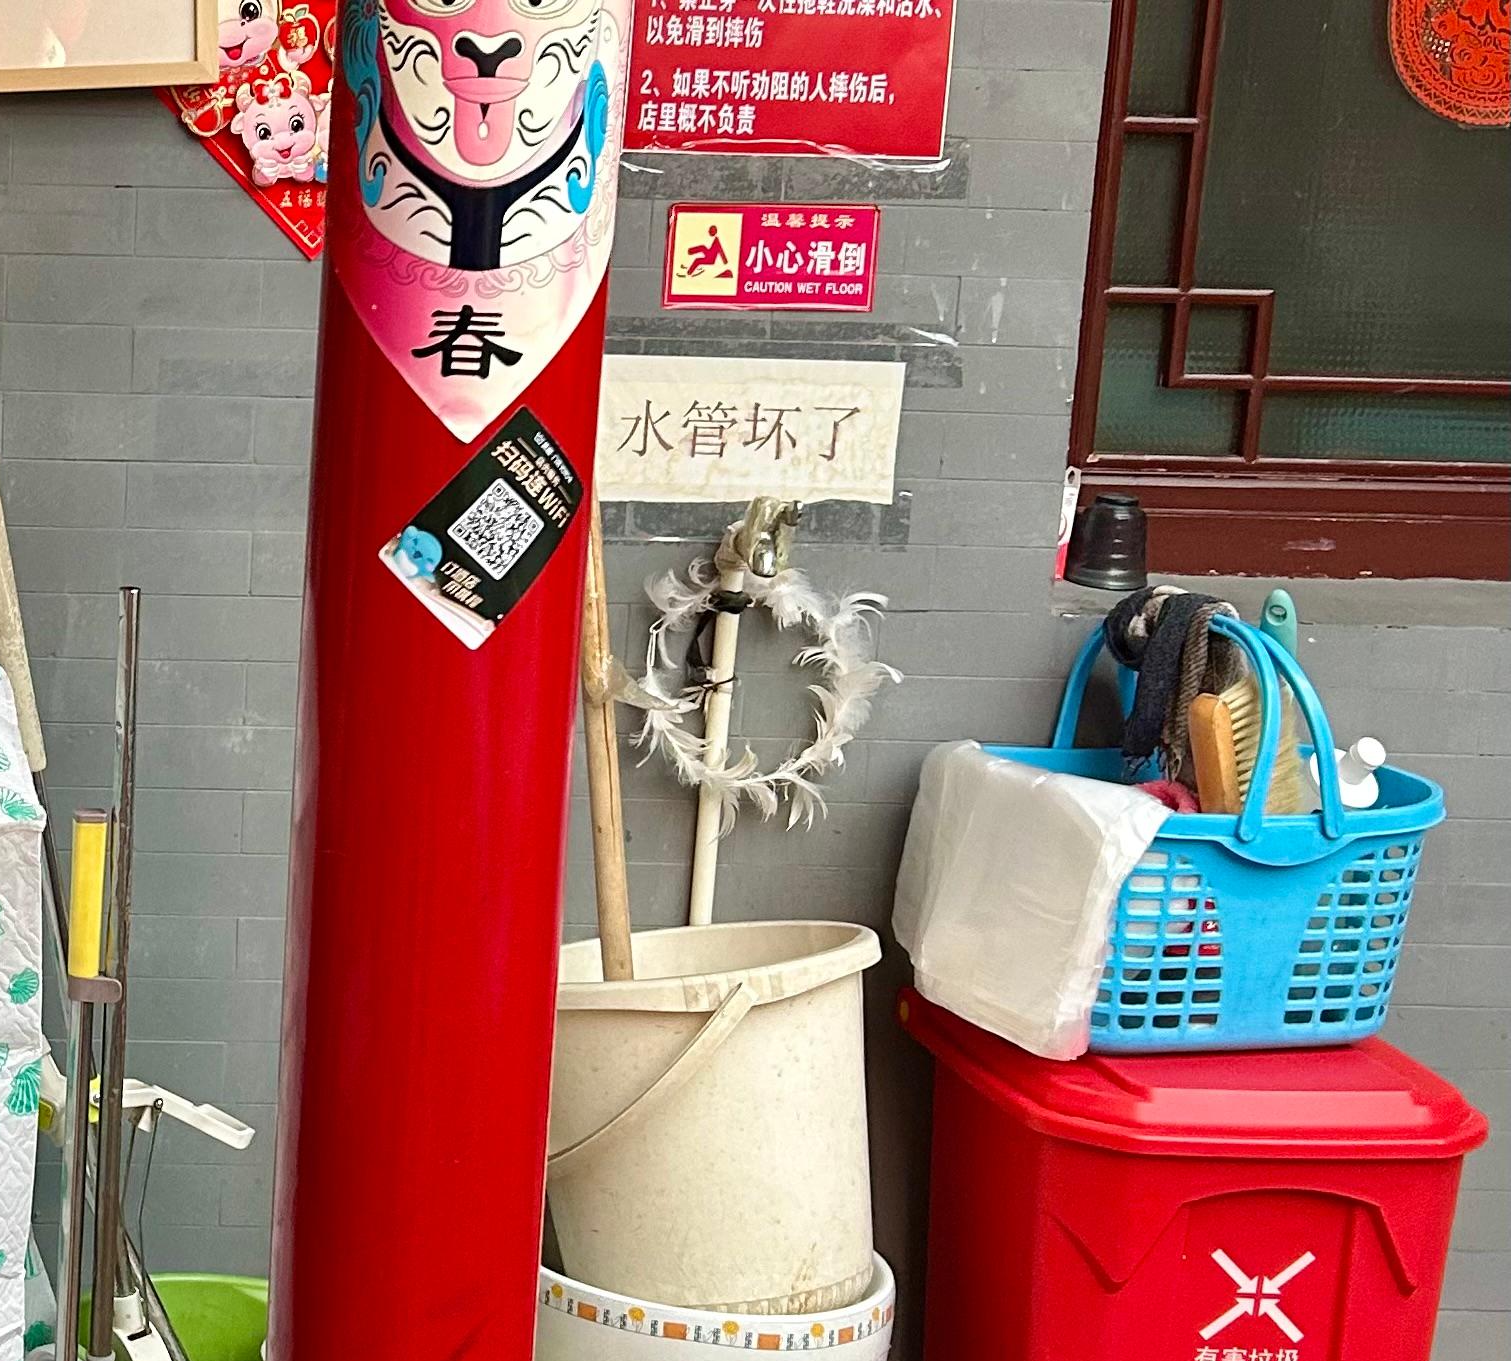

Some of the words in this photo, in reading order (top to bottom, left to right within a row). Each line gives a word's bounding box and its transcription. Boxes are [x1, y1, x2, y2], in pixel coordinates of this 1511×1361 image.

[645, 14, 765, 49] 以免滑到摔伤
[637, 100, 757, 135] 店里概不负责
[760, 212, 856, 230] 温馨提示
[744, 239, 867, 276] 小心滑倒
[743, 280, 793, 294] CAUTION
[797, 282, 822, 295] WET
[825, 282, 864, 295] FLOOR
[411, 304, 524, 380] 春
[616, 398, 864, 462] 水管坏了
